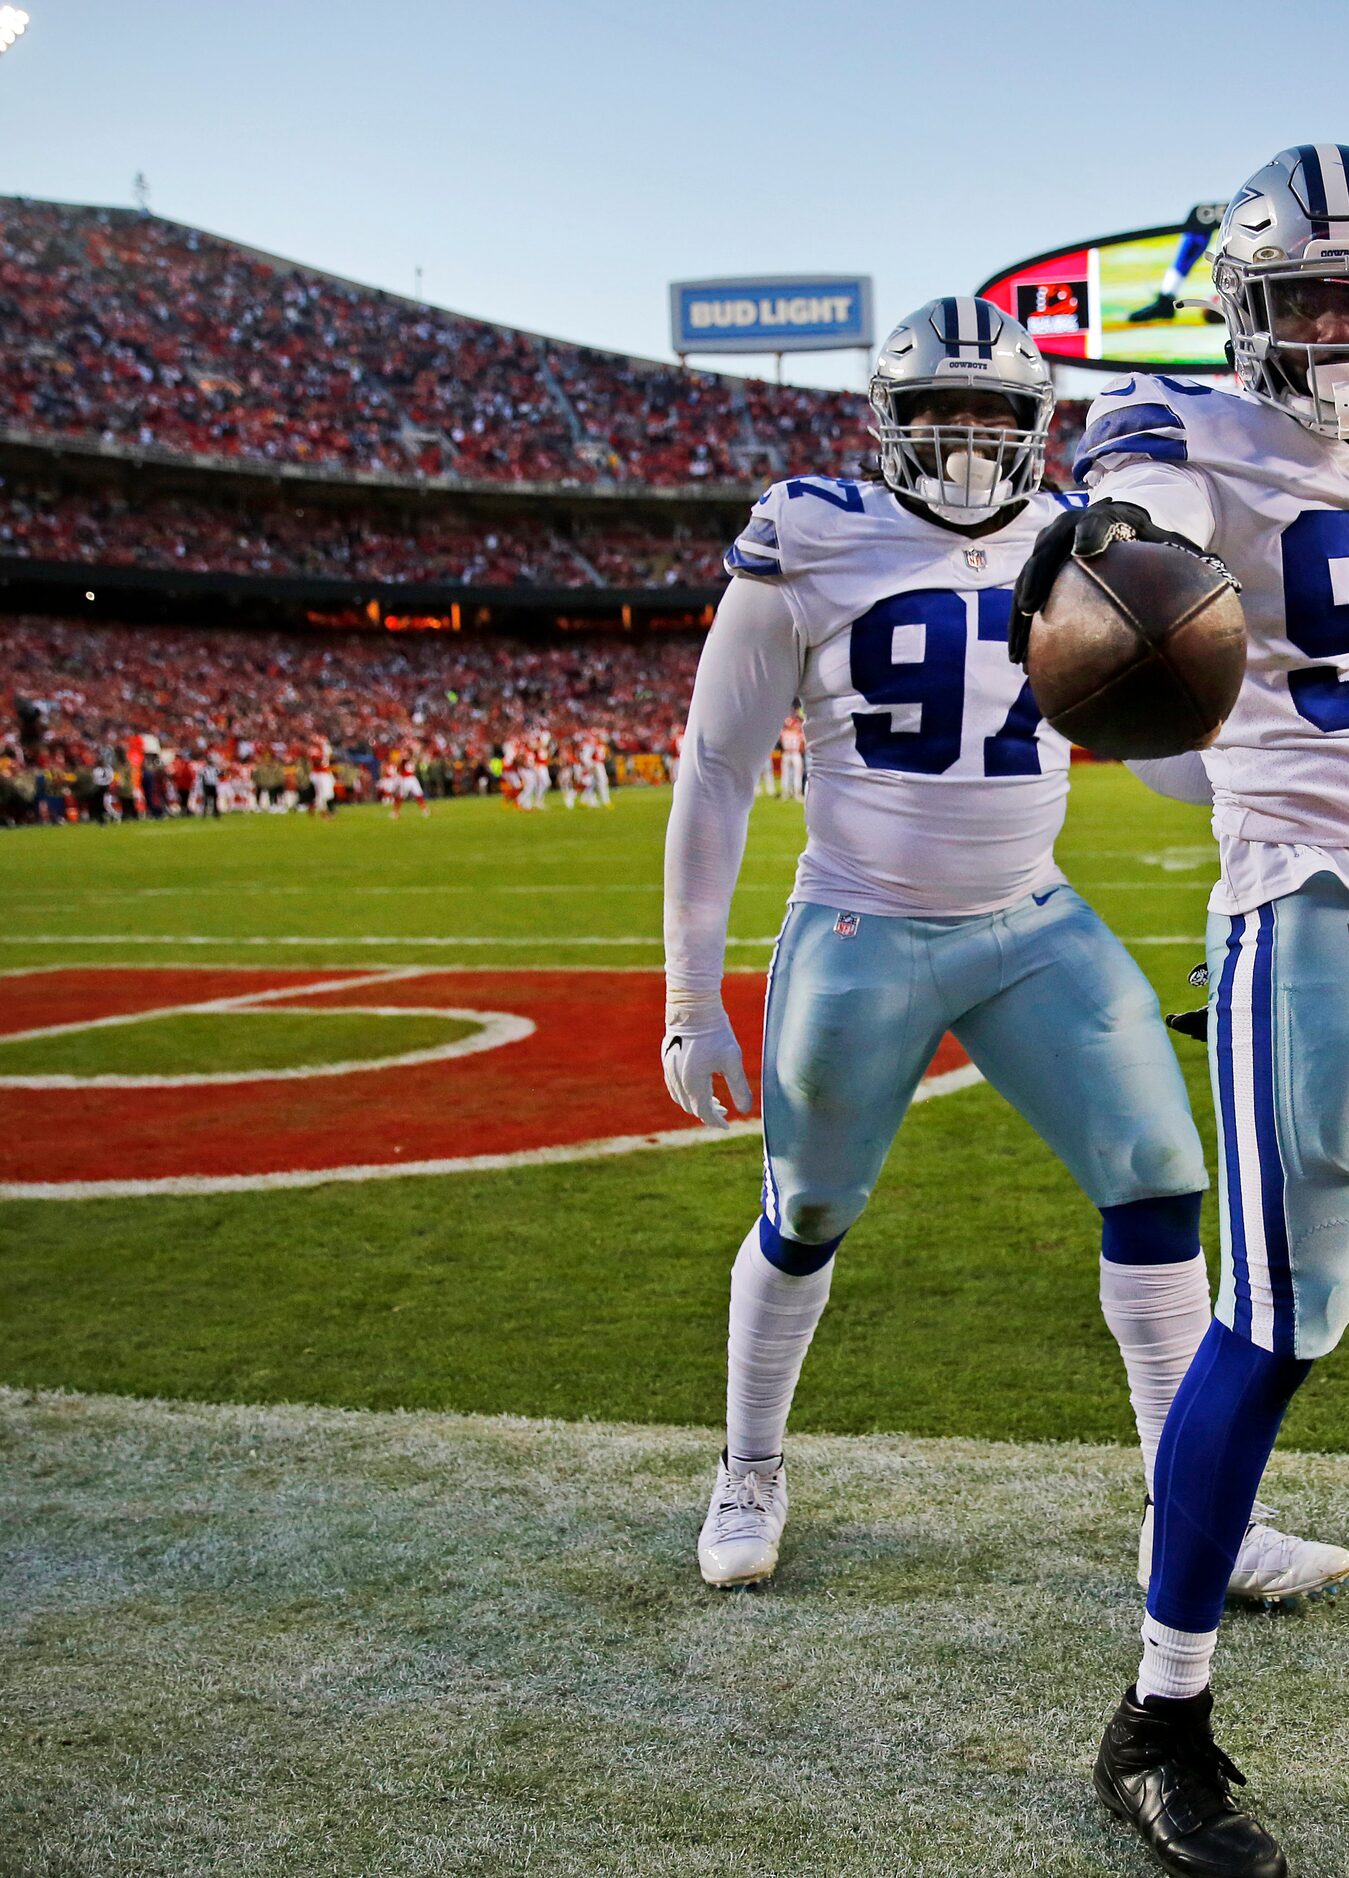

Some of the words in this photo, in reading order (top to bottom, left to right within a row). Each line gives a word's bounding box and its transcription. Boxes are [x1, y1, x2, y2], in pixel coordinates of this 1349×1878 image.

[690, 300, 757, 328] BUD
[759, 296, 852, 326] LIGHT
[949, 361, 988, 370] COWBOYS
[850, 588, 1042, 778] 97
